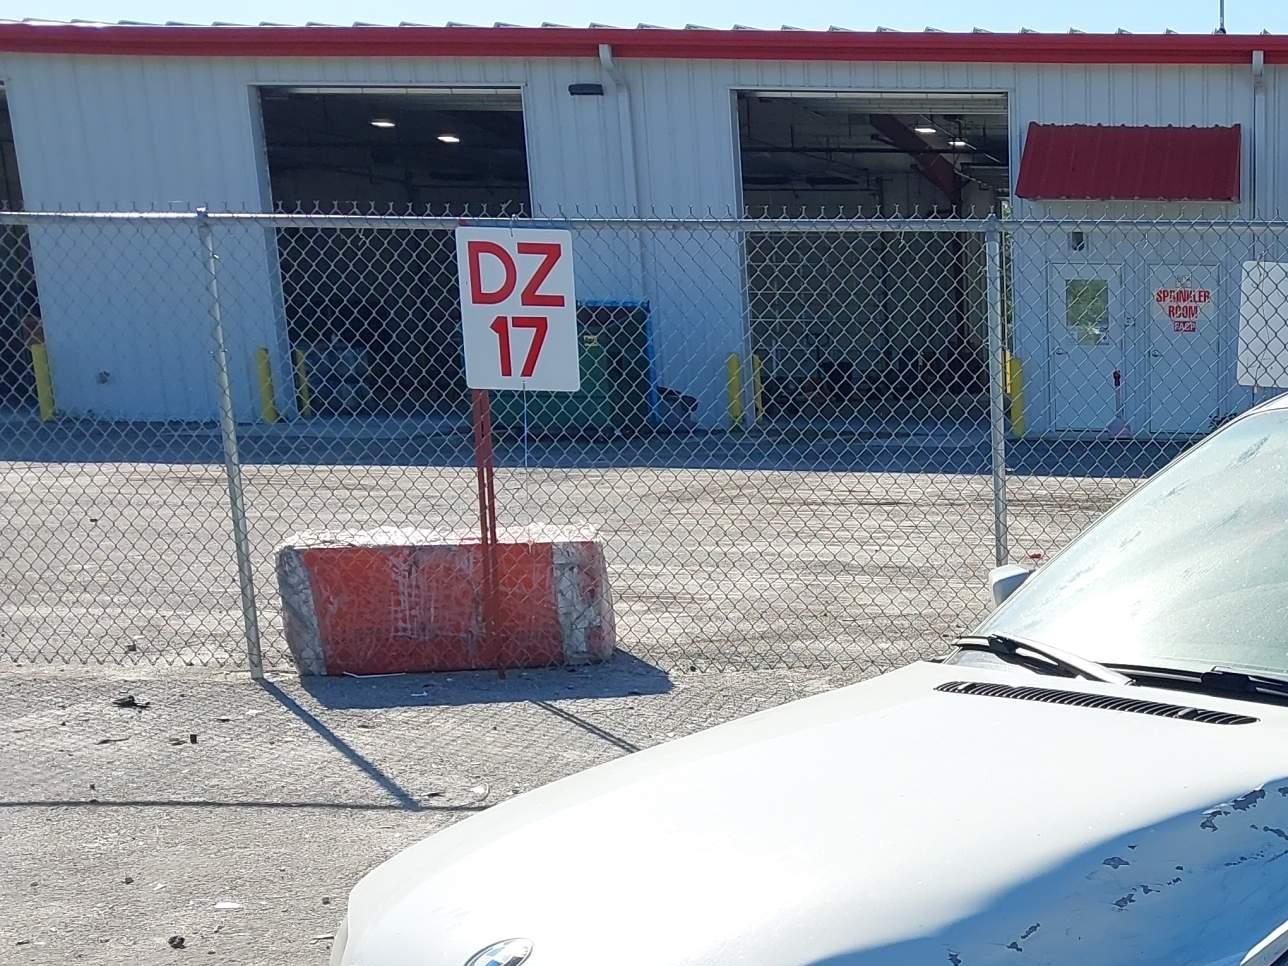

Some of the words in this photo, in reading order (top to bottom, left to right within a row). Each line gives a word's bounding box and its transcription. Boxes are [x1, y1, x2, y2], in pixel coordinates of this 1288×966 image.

[467, 241, 565, 307] DZ
[1156, 289, 1211, 303] SPRINKLER
[1168, 305, 1198, 319] ROOM
[489, 316, 548, 377] 17
